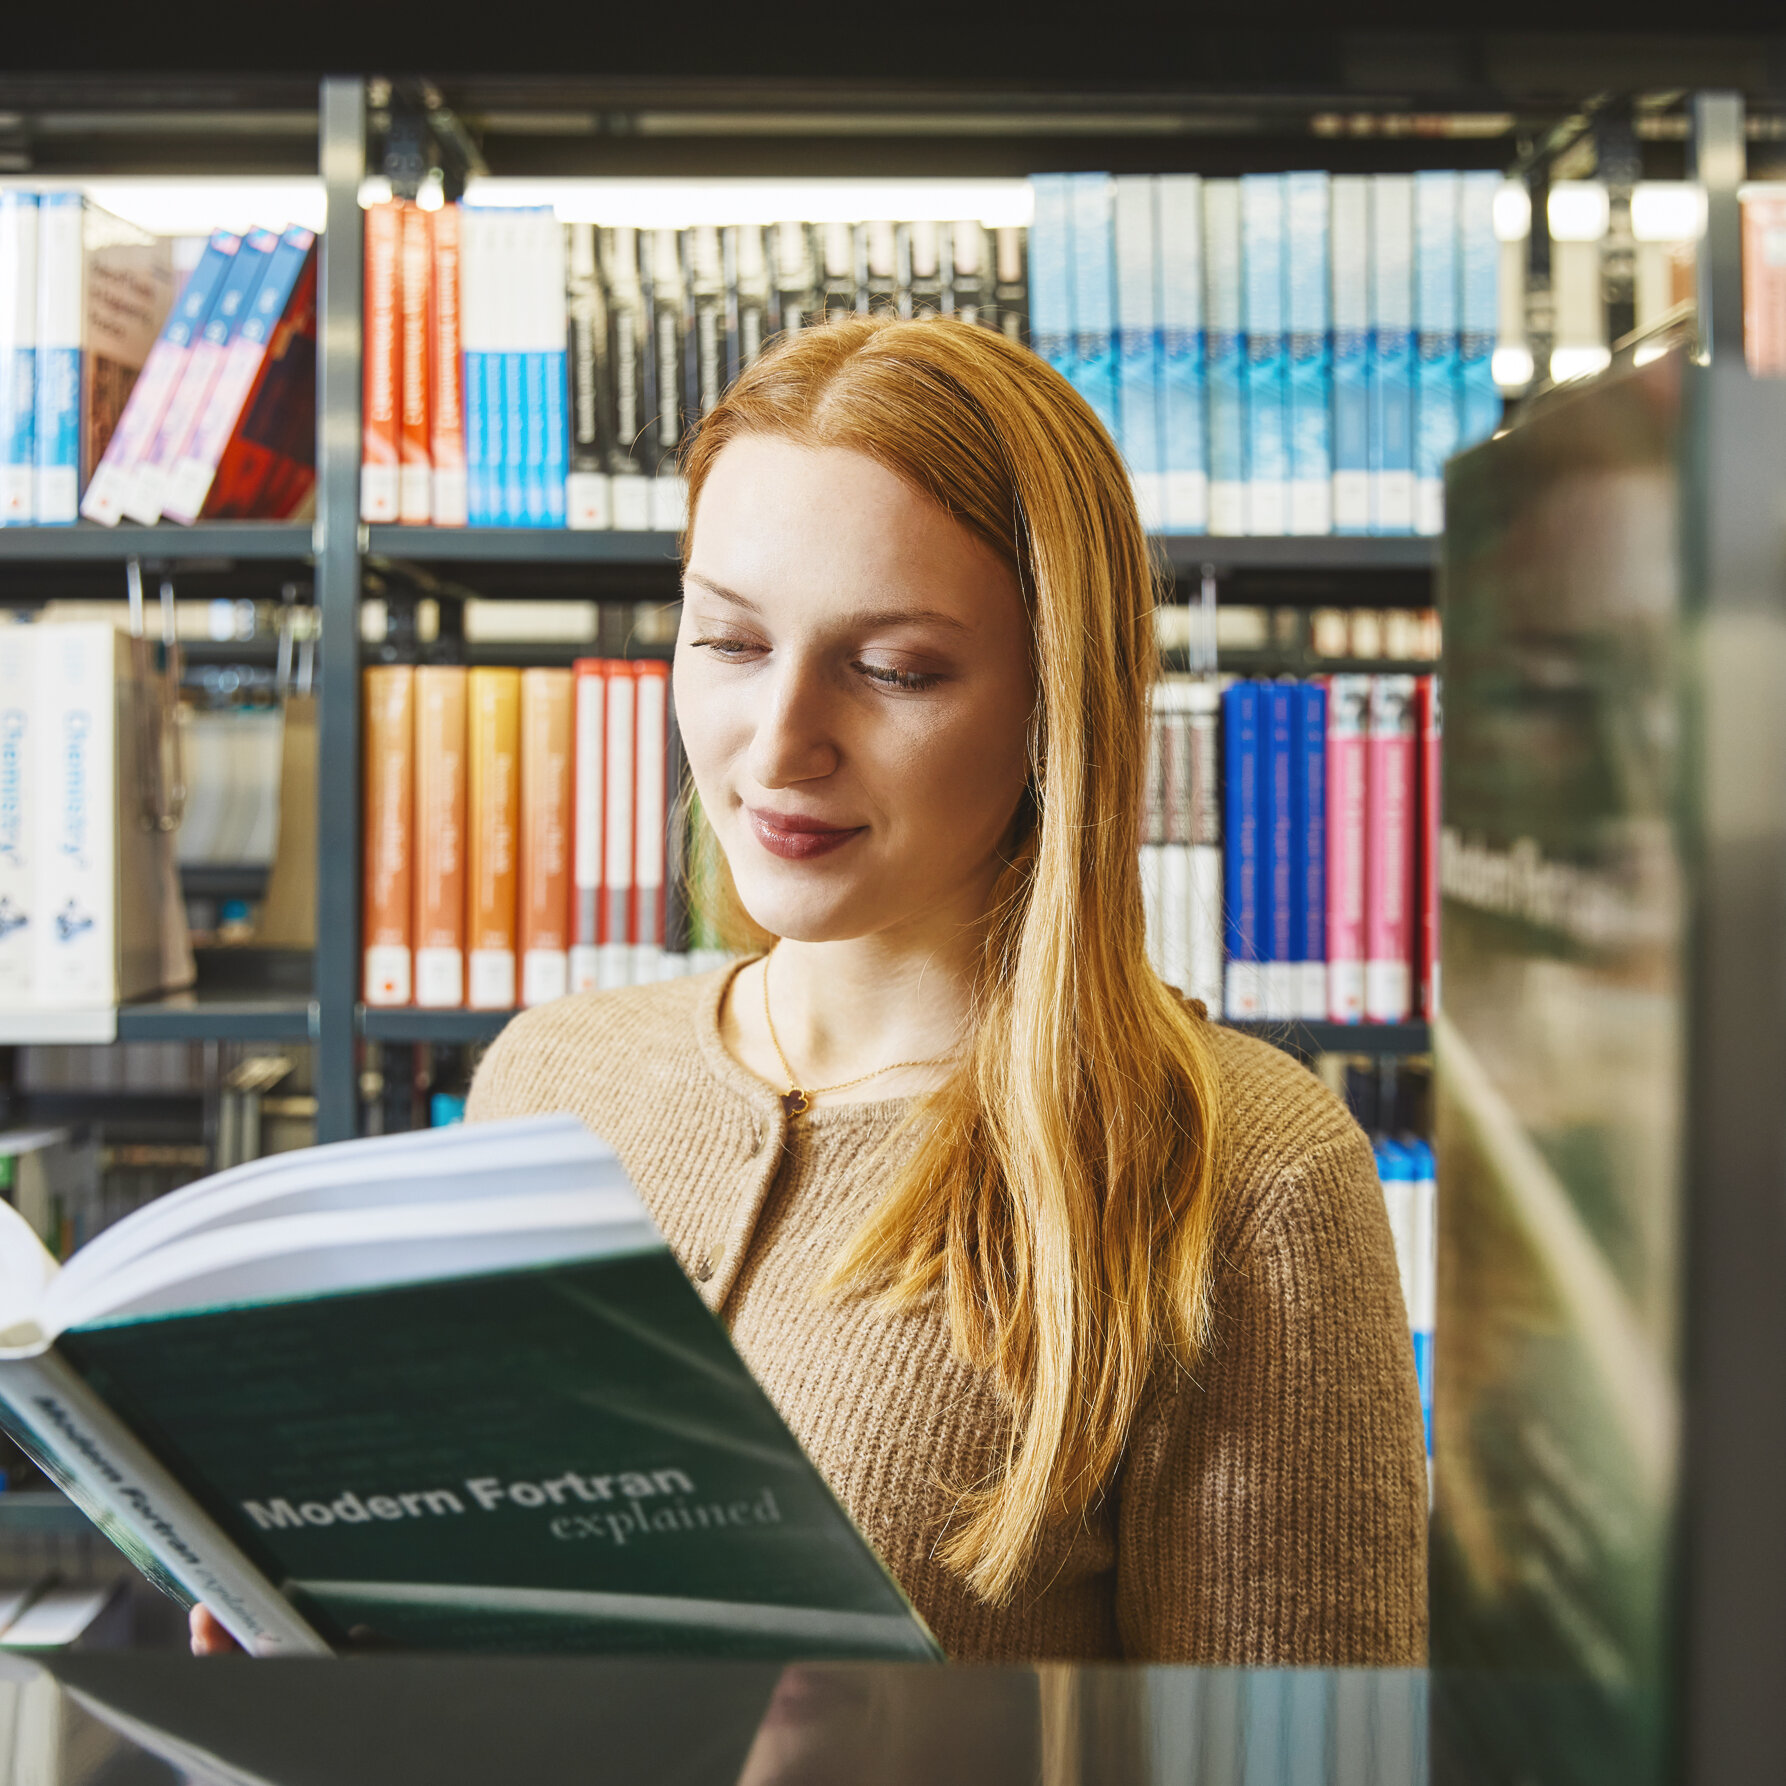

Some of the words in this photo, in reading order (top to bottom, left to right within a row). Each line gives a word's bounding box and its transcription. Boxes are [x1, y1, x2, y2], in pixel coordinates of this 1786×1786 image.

[33, 1395, 122, 1483] Modern
[118, 1486, 200, 1565] Fortran
[243, 1487, 464, 1530] Modern
[466, 1468, 695, 1511] Fortran
[549, 1487, 783, 1545] explained
